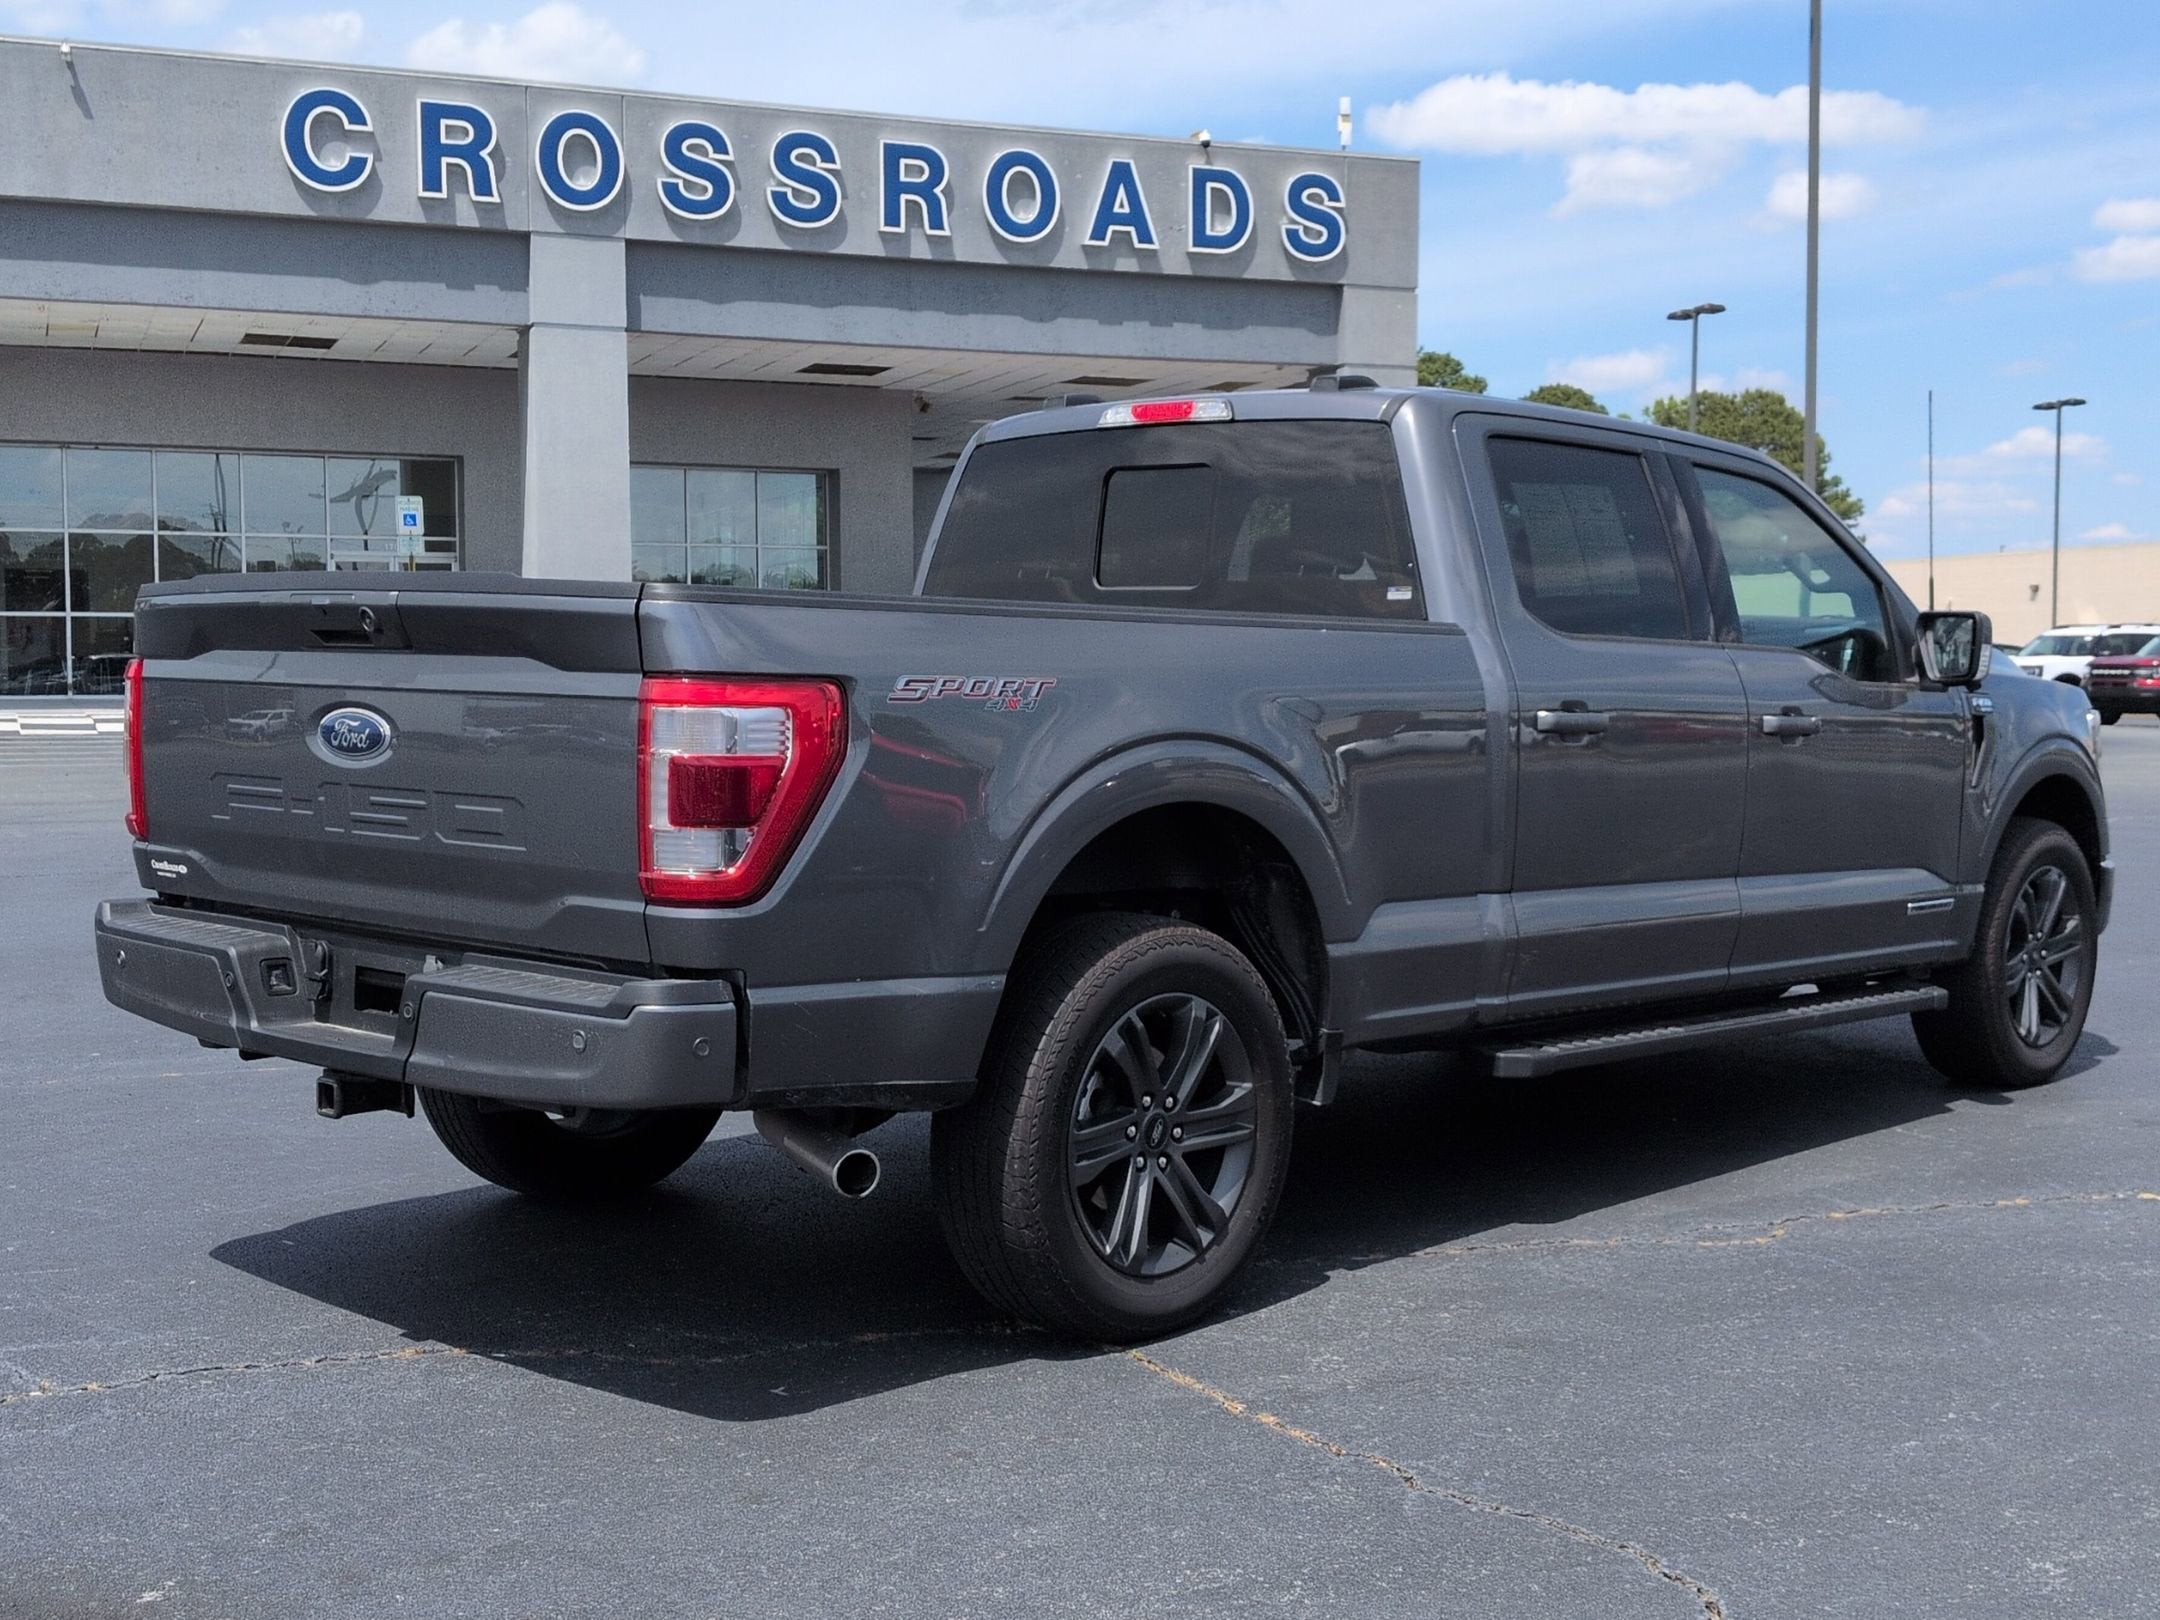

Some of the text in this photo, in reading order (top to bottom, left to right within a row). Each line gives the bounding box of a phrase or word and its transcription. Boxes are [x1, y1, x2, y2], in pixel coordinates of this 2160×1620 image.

[280, 86, 1347, 262] CROSSROADS
[887, 675, 1057, 703] SPORT
[331, 718, 370, 748] Ford
[210, 771, 527, 851] F-150
